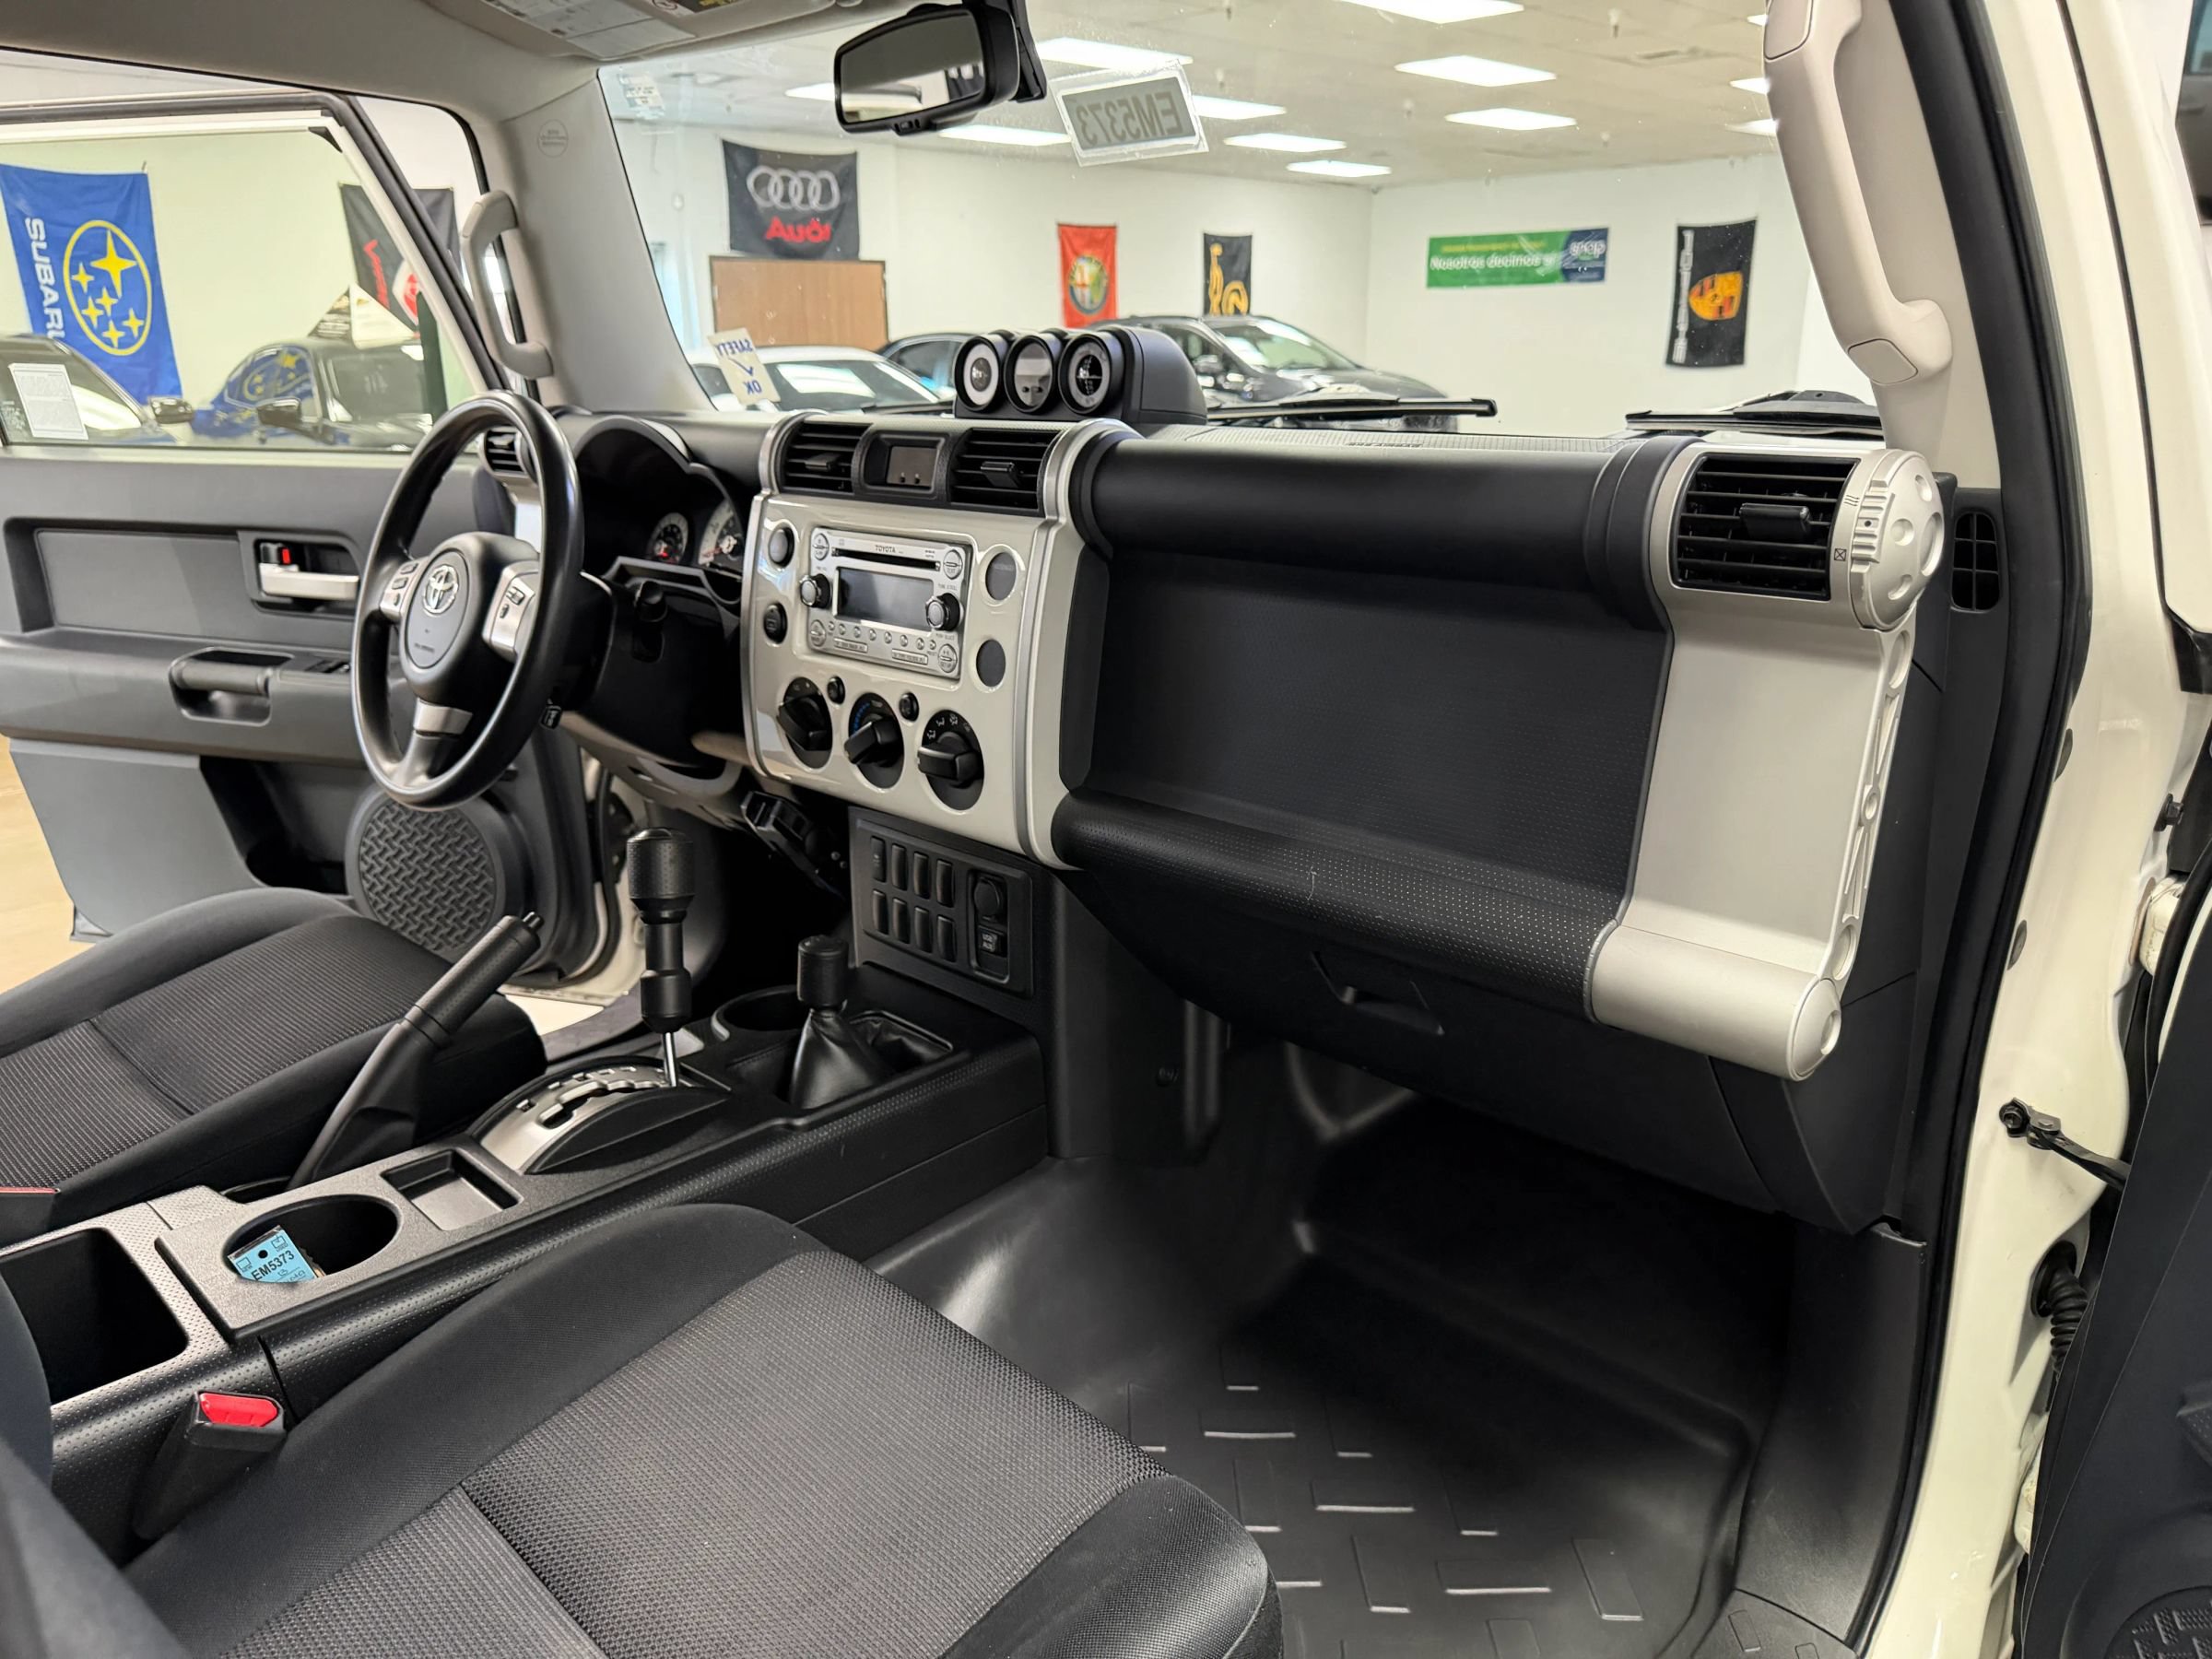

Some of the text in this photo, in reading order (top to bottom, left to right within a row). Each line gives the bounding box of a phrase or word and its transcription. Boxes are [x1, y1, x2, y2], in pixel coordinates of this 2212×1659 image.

[765, 215, 831, 244] Audi
[875, 544, 896, 554] TOYOTA
[252, 1250, 294, 1280] EM5373
